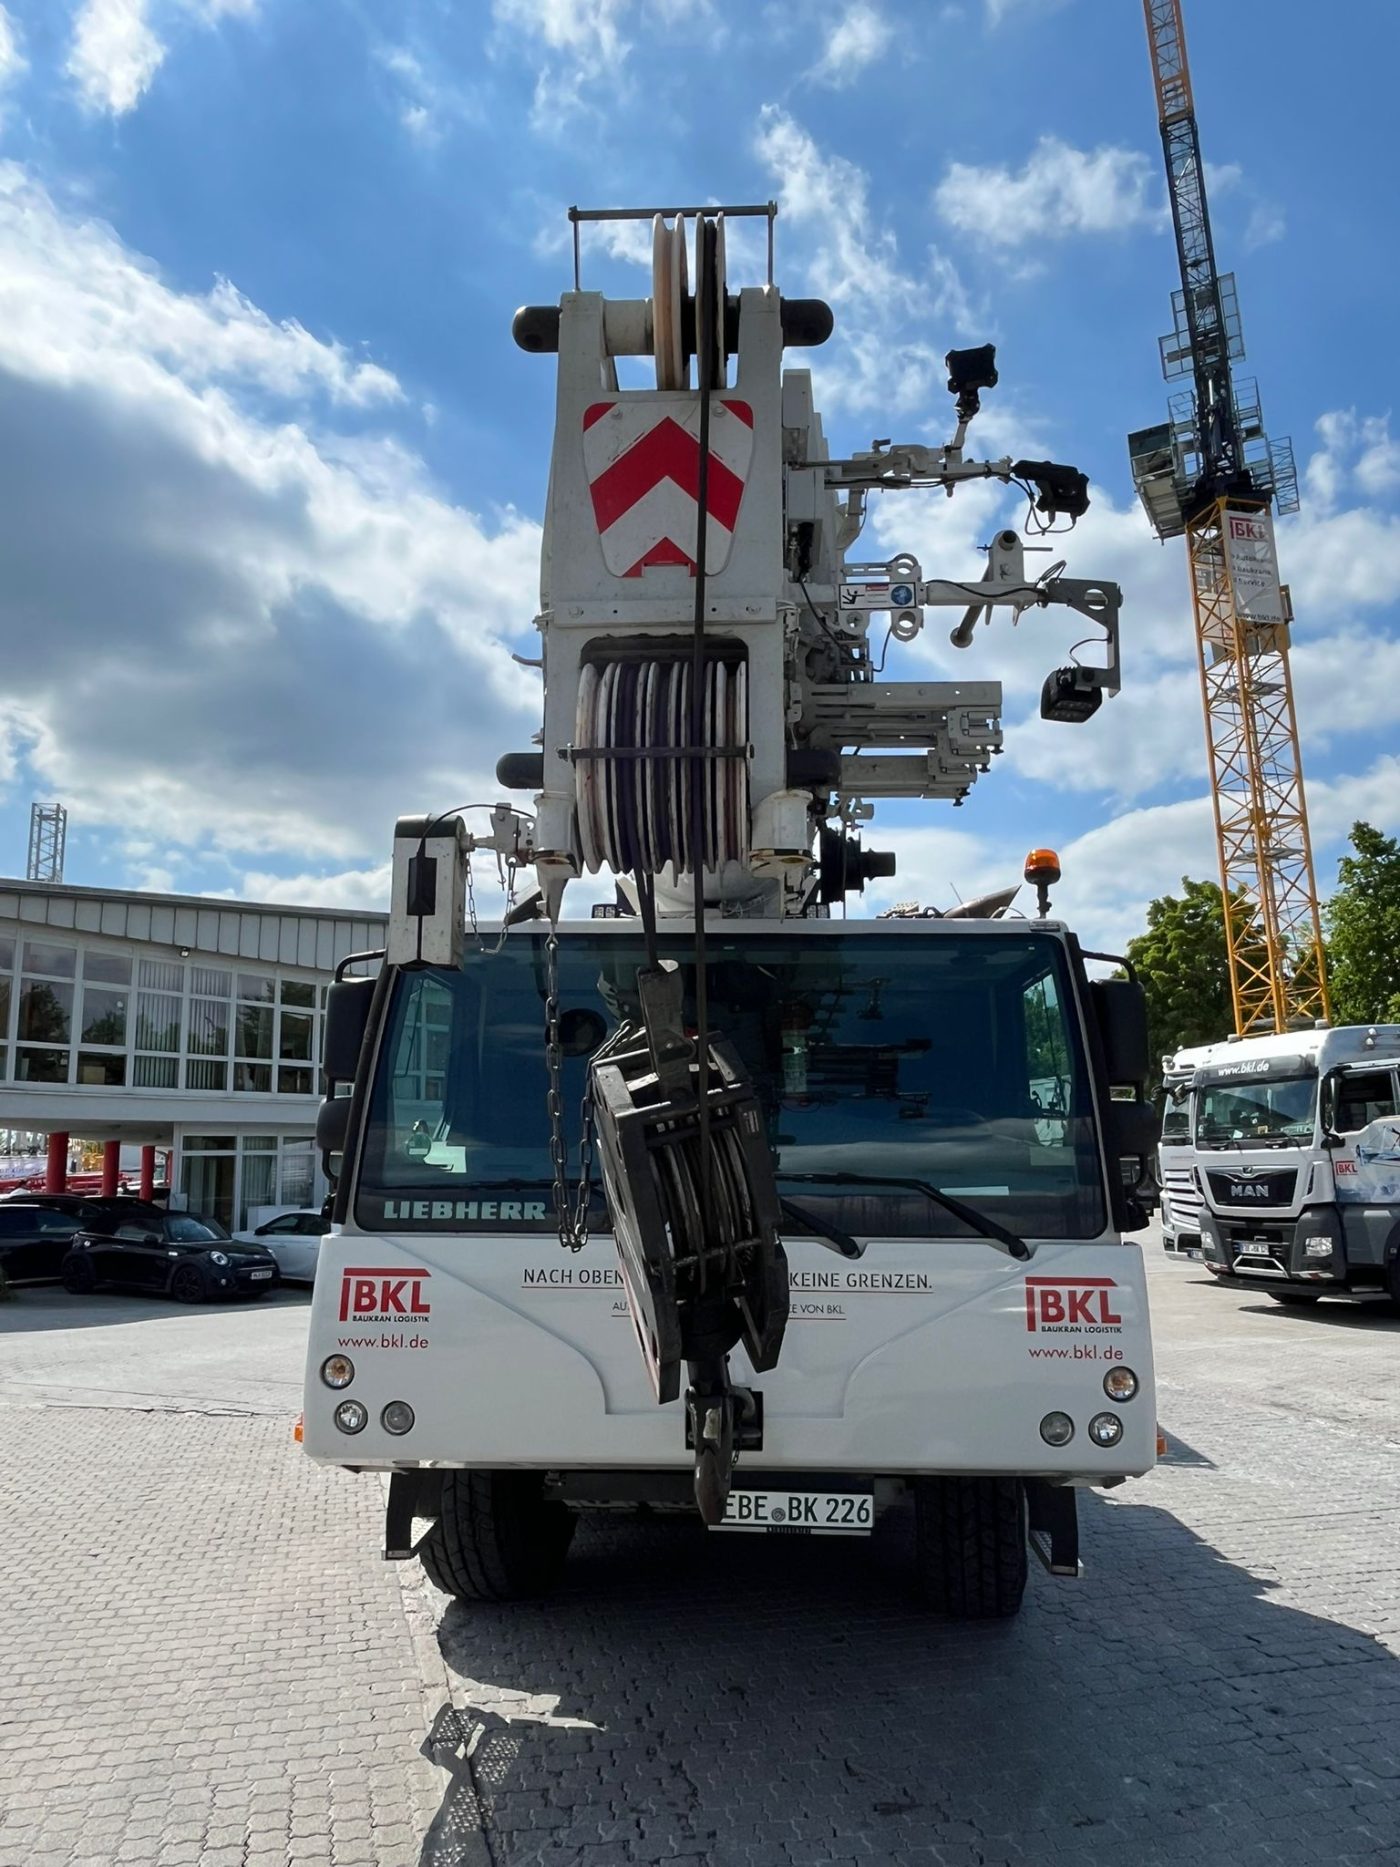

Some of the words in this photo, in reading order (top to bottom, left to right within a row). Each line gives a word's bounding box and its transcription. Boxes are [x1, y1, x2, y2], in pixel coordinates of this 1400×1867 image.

[1218, 1060, 1270, 1077] www.bkl.de
[1337, 1163, 1358, 1174] BKL
[1230, 1184, 1269, 1198] MAN
[383, 1200, 546, 1220] LIEBHERR
[523, 1268, 573, 1284] NACH
[789, 1272, 841, 1288] KEINE
[846, 1273, 933, 1290] GRENZEN.
[353, 1279, 431, 1313] BKL
[612, 1302, 630, 1311] AU
[800, 1303, 825, 1314] VON
[1040, 1289, 1122, 1324] BKL
[352, 1315, 392, 1323] BAUKRAN
[393, 1315, 430, 1323] LOGISTIK
[1041, 1325, 1082, 1333] BAUKRAN
[1084, 1326, 1123, 1334] LOGISTIK
[337, 1333, 430, 1349] www.bkl.de
[1028, 1344, 1124, 1360] www.bkl.de
[788, 1496, 818, 1522] BK
[826, 1498, 870, 1523] 226
